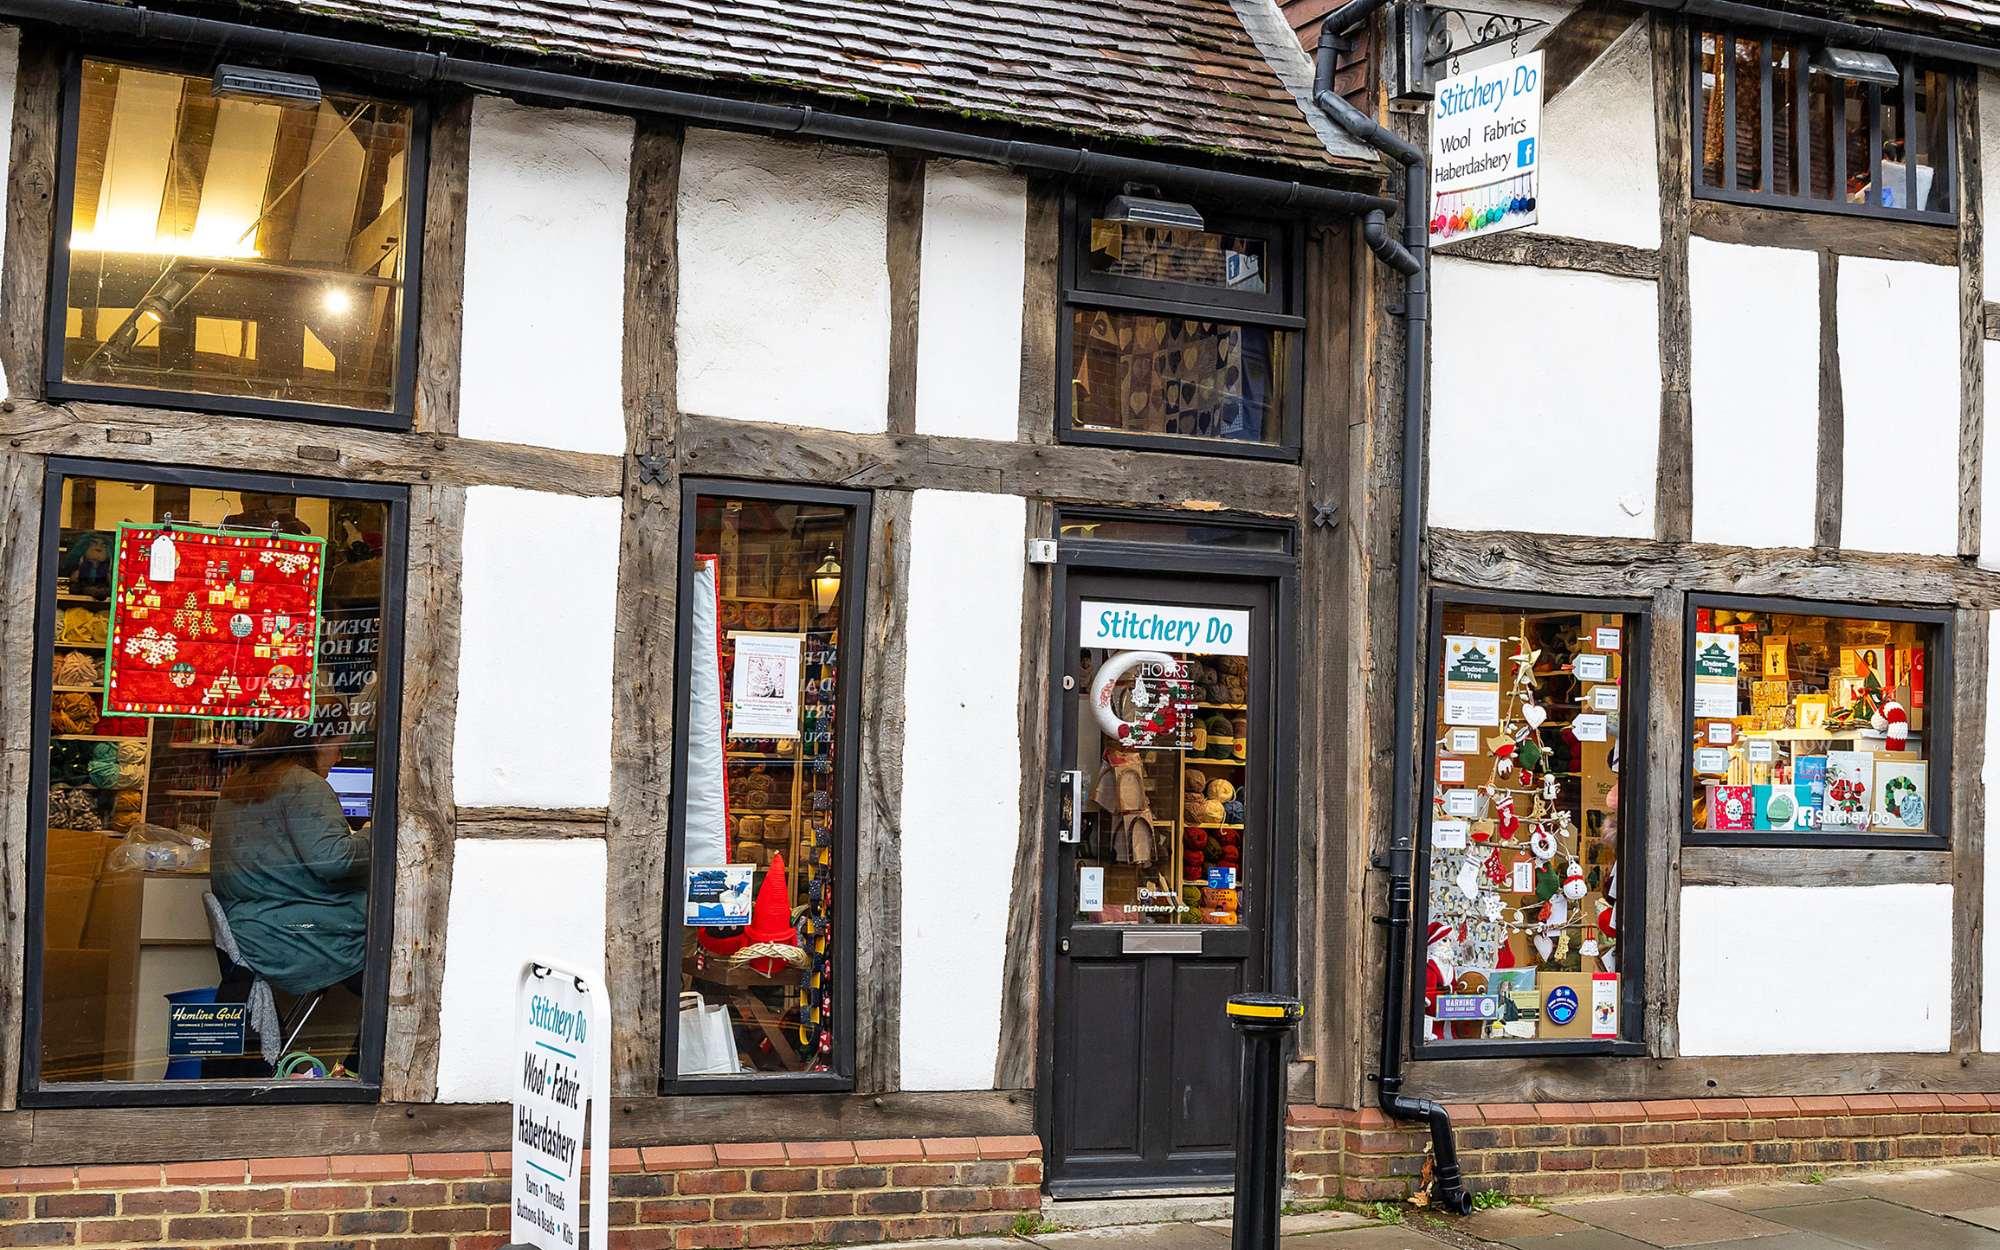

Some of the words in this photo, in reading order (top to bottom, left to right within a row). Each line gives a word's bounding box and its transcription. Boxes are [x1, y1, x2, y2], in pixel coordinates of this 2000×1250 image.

[1437, 75, 1509, 119] Stitchery
[1513, 65, 1536, 97] Do
[1440, 128, 1471, 154] Wool
[1483, 117, 1526, 143] Fabrics
[1435, 152, 1511, 183] Haberdashery
[1097, 610, 1200, 647] Stitchery
[1206, 617, 1233, 644] Do
[1141, 662, 1188, 679] HOURS
[1460, 665, 1488, 673] Kindness
[1815, 810, 1890, 828] StitcheryDo
[1131, 904, 1175, 913] Stitchery
[172, 1006, 214, 1021] Hemline
[216, 1007, 244, 1021] Gold
[529, 994, 575, 1044] Stitchery
[574, 1010, 587, 1044] Do
[1445, 998, 1476, 1007] WARNING!
[523, 1050, 547, 1096] Wool
[551, 1062, 581, 1110] Fabric
[518, 1104, 577, 1178] Haberdashery
[525, 1172, 539, 1197] Yarns
[544, 1183, 565, 1211] Threads
[516, 1197, 537, 1225] Buttons
[541, 1210, 555, 1236] Beads
[562, 1222, 574, 1245] Kits
